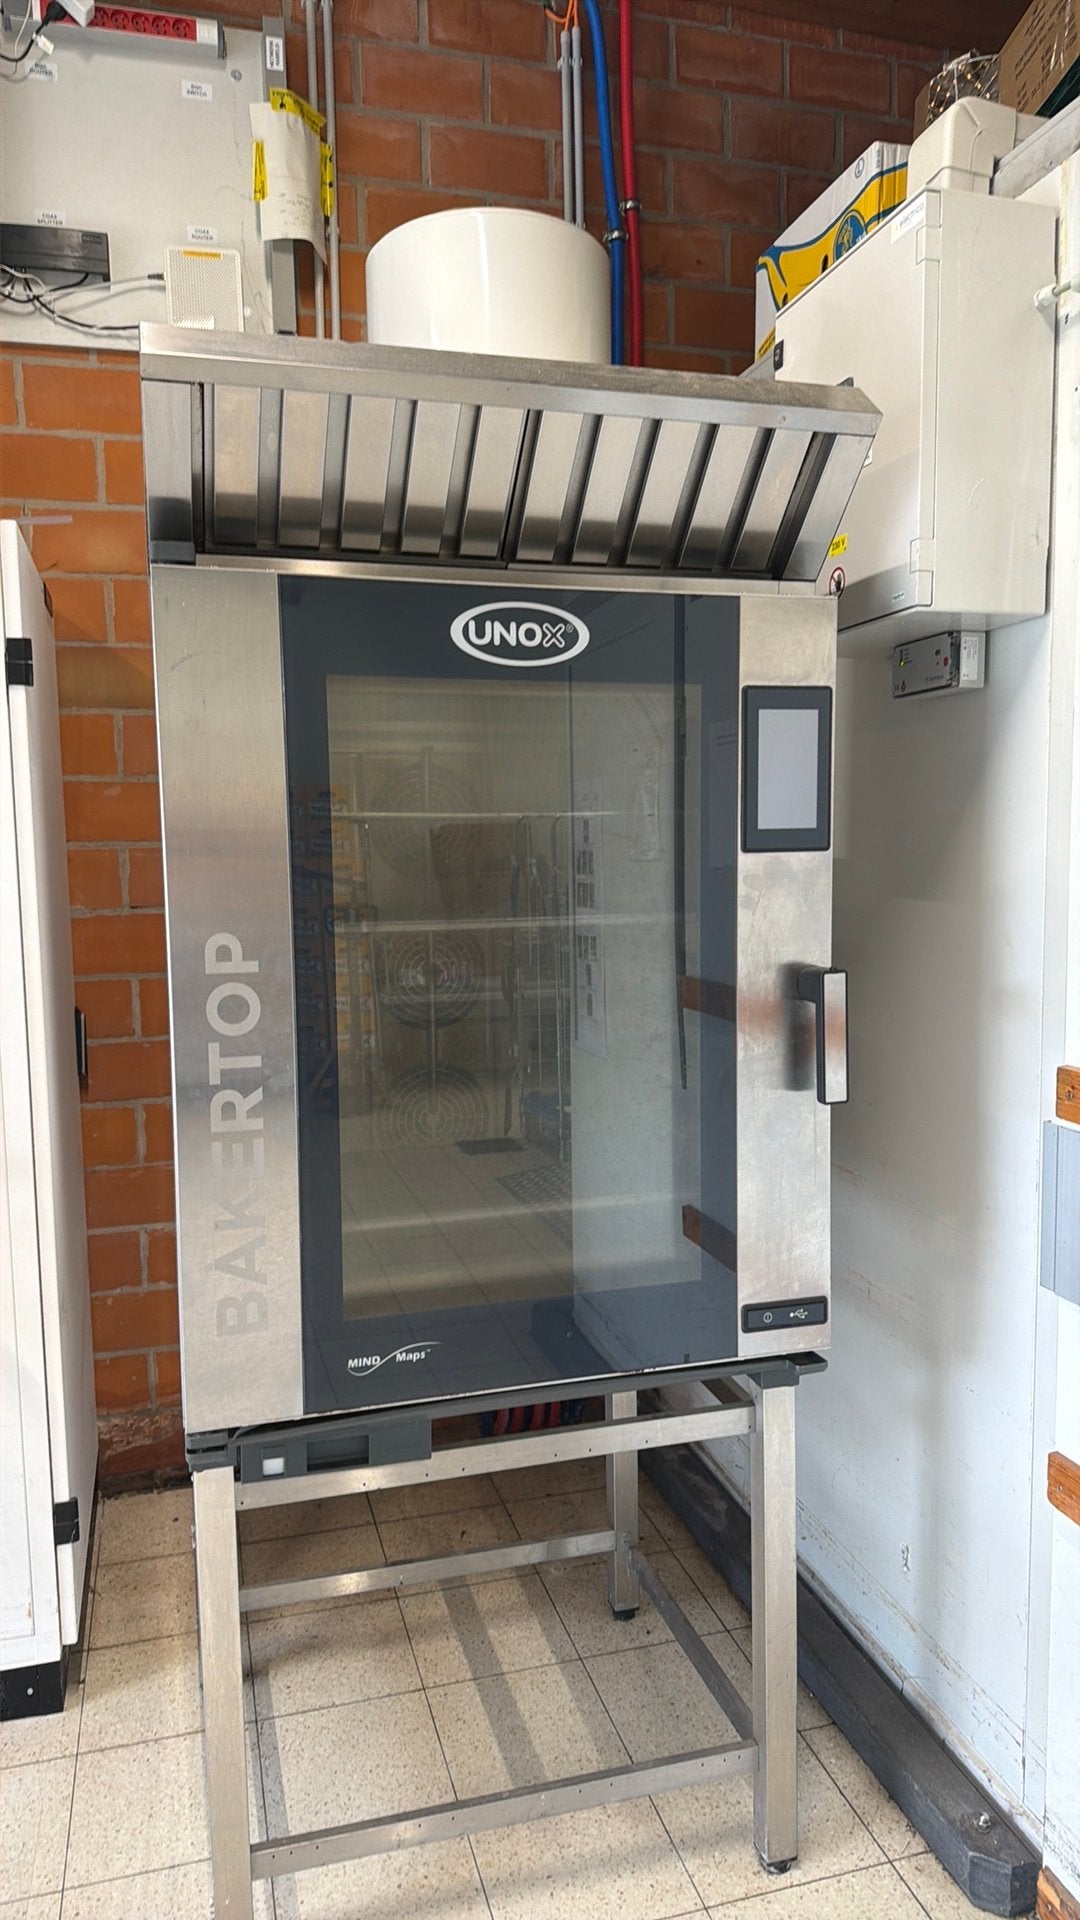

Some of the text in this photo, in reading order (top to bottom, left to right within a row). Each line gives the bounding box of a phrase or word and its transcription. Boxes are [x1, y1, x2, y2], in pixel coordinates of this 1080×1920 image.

[204, 932, 269, 1337] BAKERTOP
[347, 1350, 426, 1369] MIND Maps
